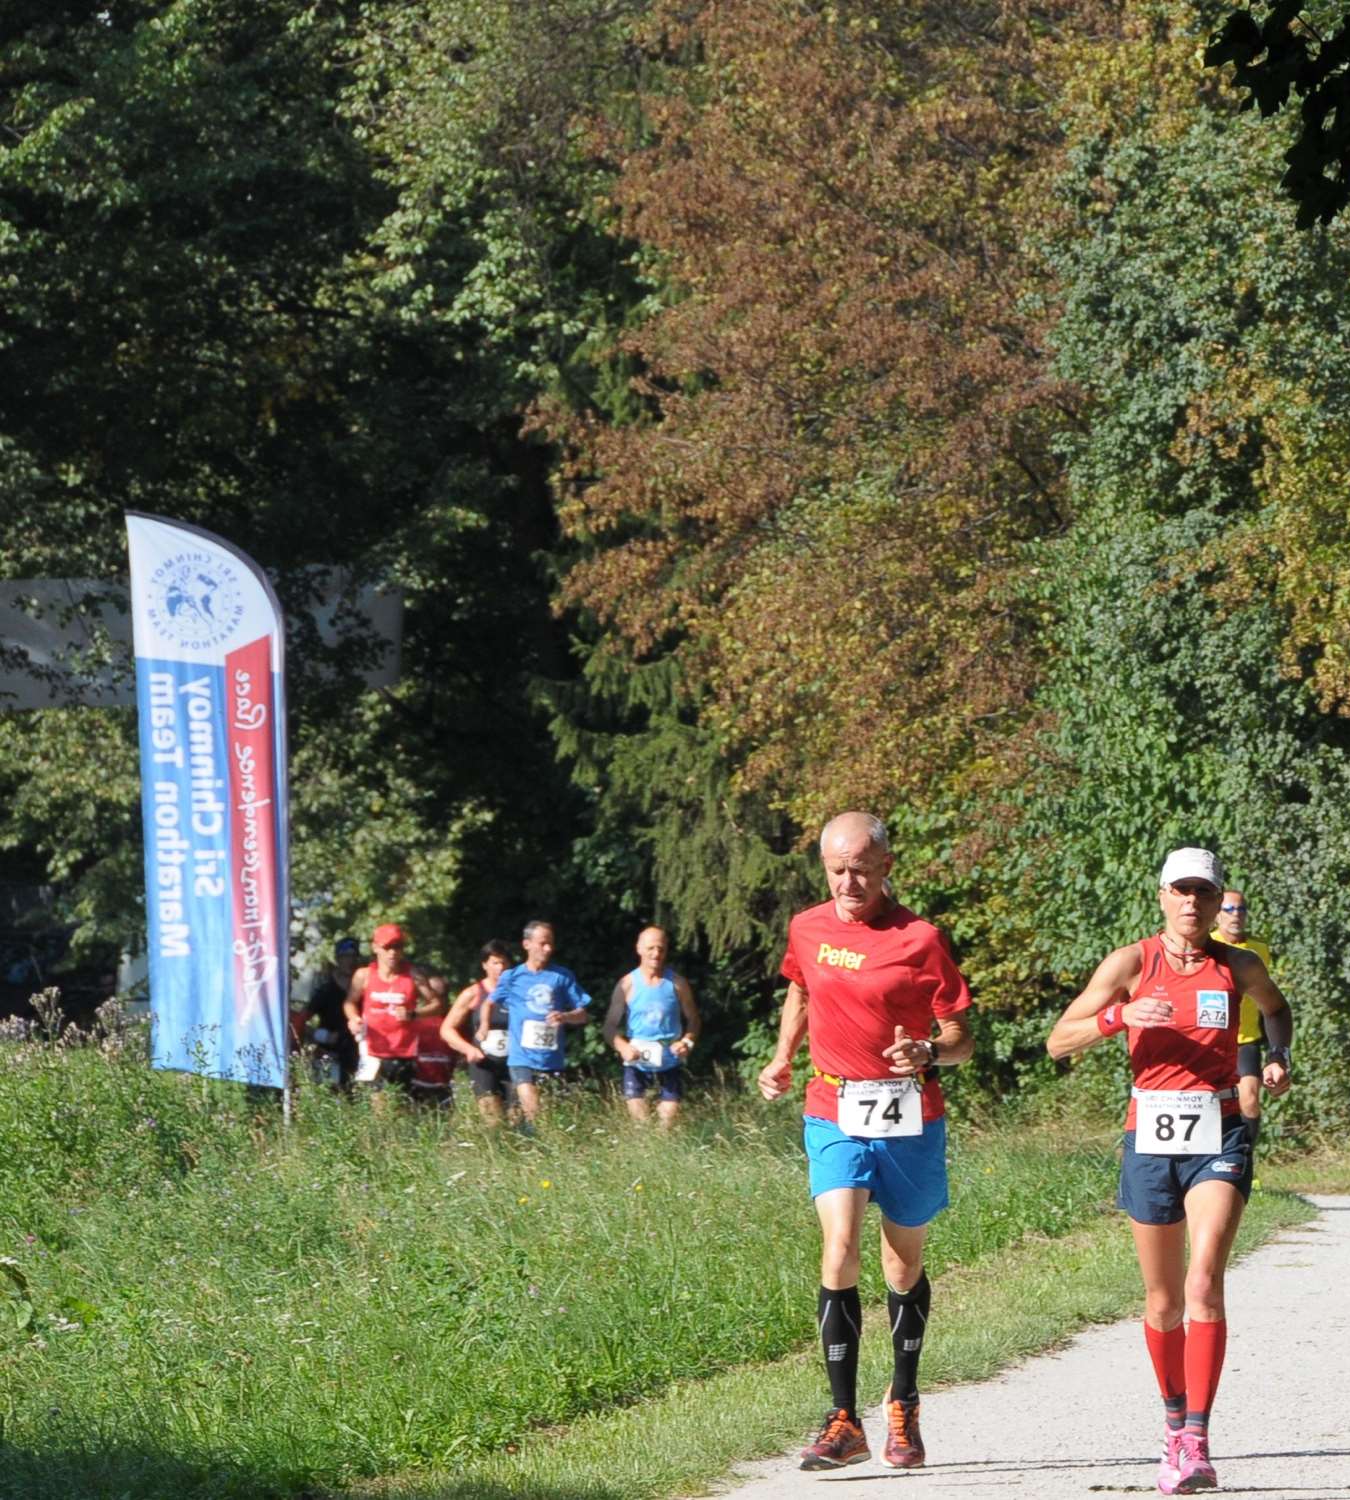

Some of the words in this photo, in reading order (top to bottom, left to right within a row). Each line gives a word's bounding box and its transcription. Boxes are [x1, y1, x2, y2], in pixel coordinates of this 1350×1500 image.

[816, 942, 867, 971] Peter
[858, 1097, 903, 1126] 74
[1155, 1113, 1201, 1142] 87
